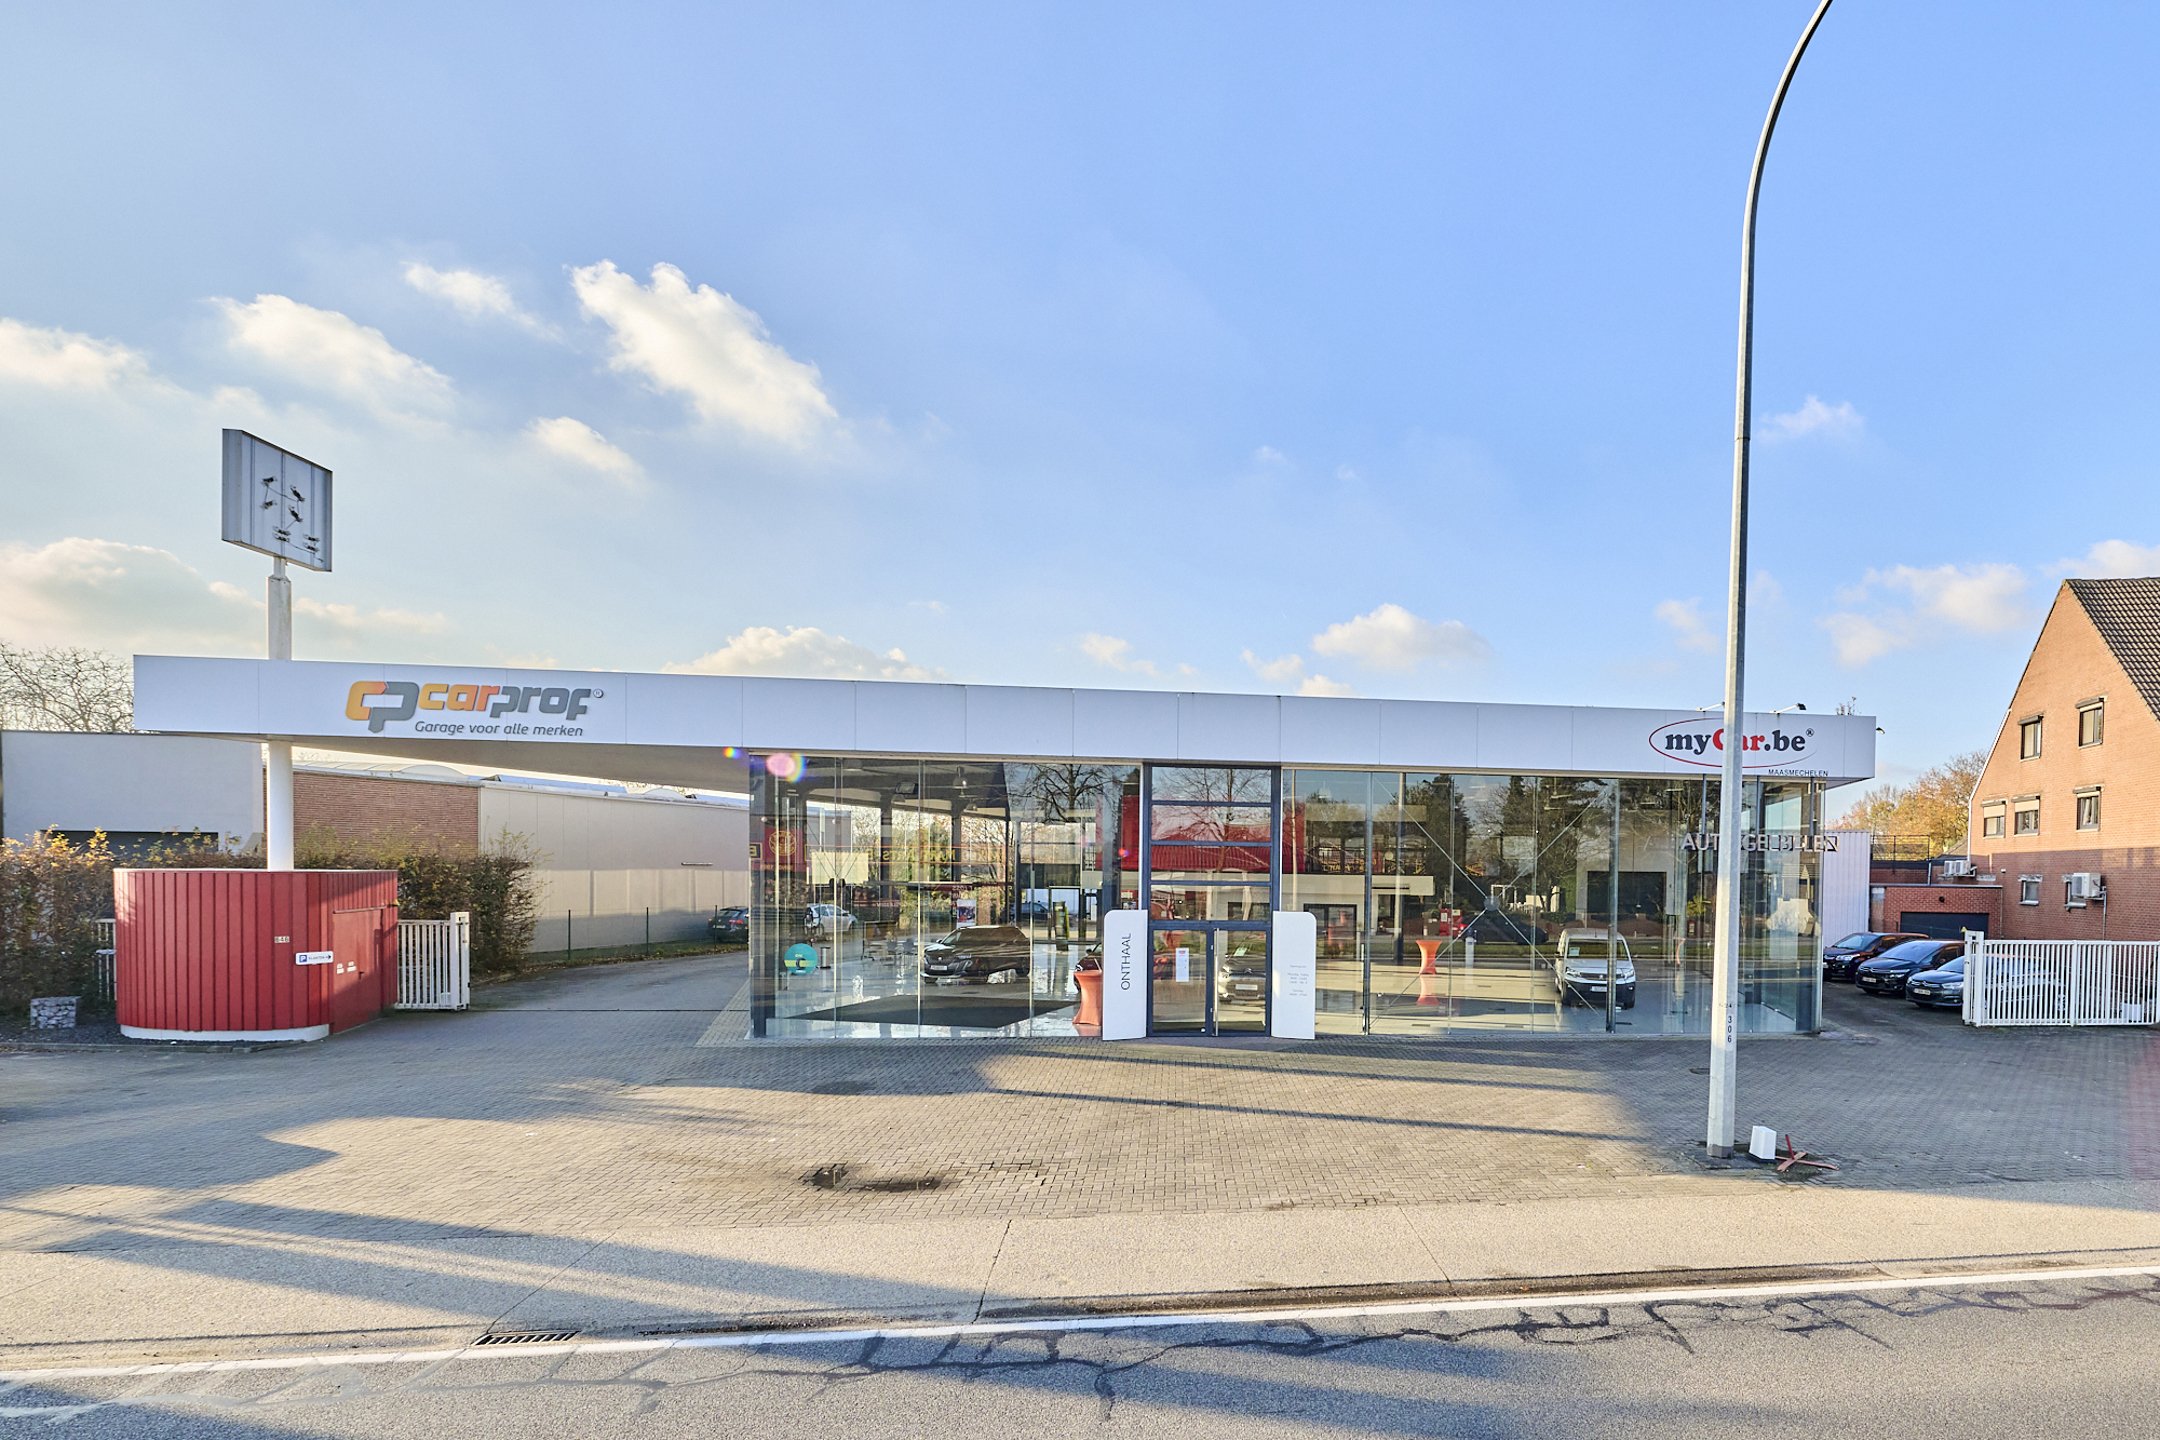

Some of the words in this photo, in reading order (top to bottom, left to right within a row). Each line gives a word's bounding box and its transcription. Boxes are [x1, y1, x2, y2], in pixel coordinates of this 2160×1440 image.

[418, 683, 592, 721] carprof
[415, 720, 464, 736] Garage
[469, 724, 500, 734] voor
[503, 723, 529, 735] alle
[533, 724, 583, 736] merken
[1768, 768, 1828, 777] MAASMECHELEN
[1120, 933, 1131, 990] ONTHAAL
